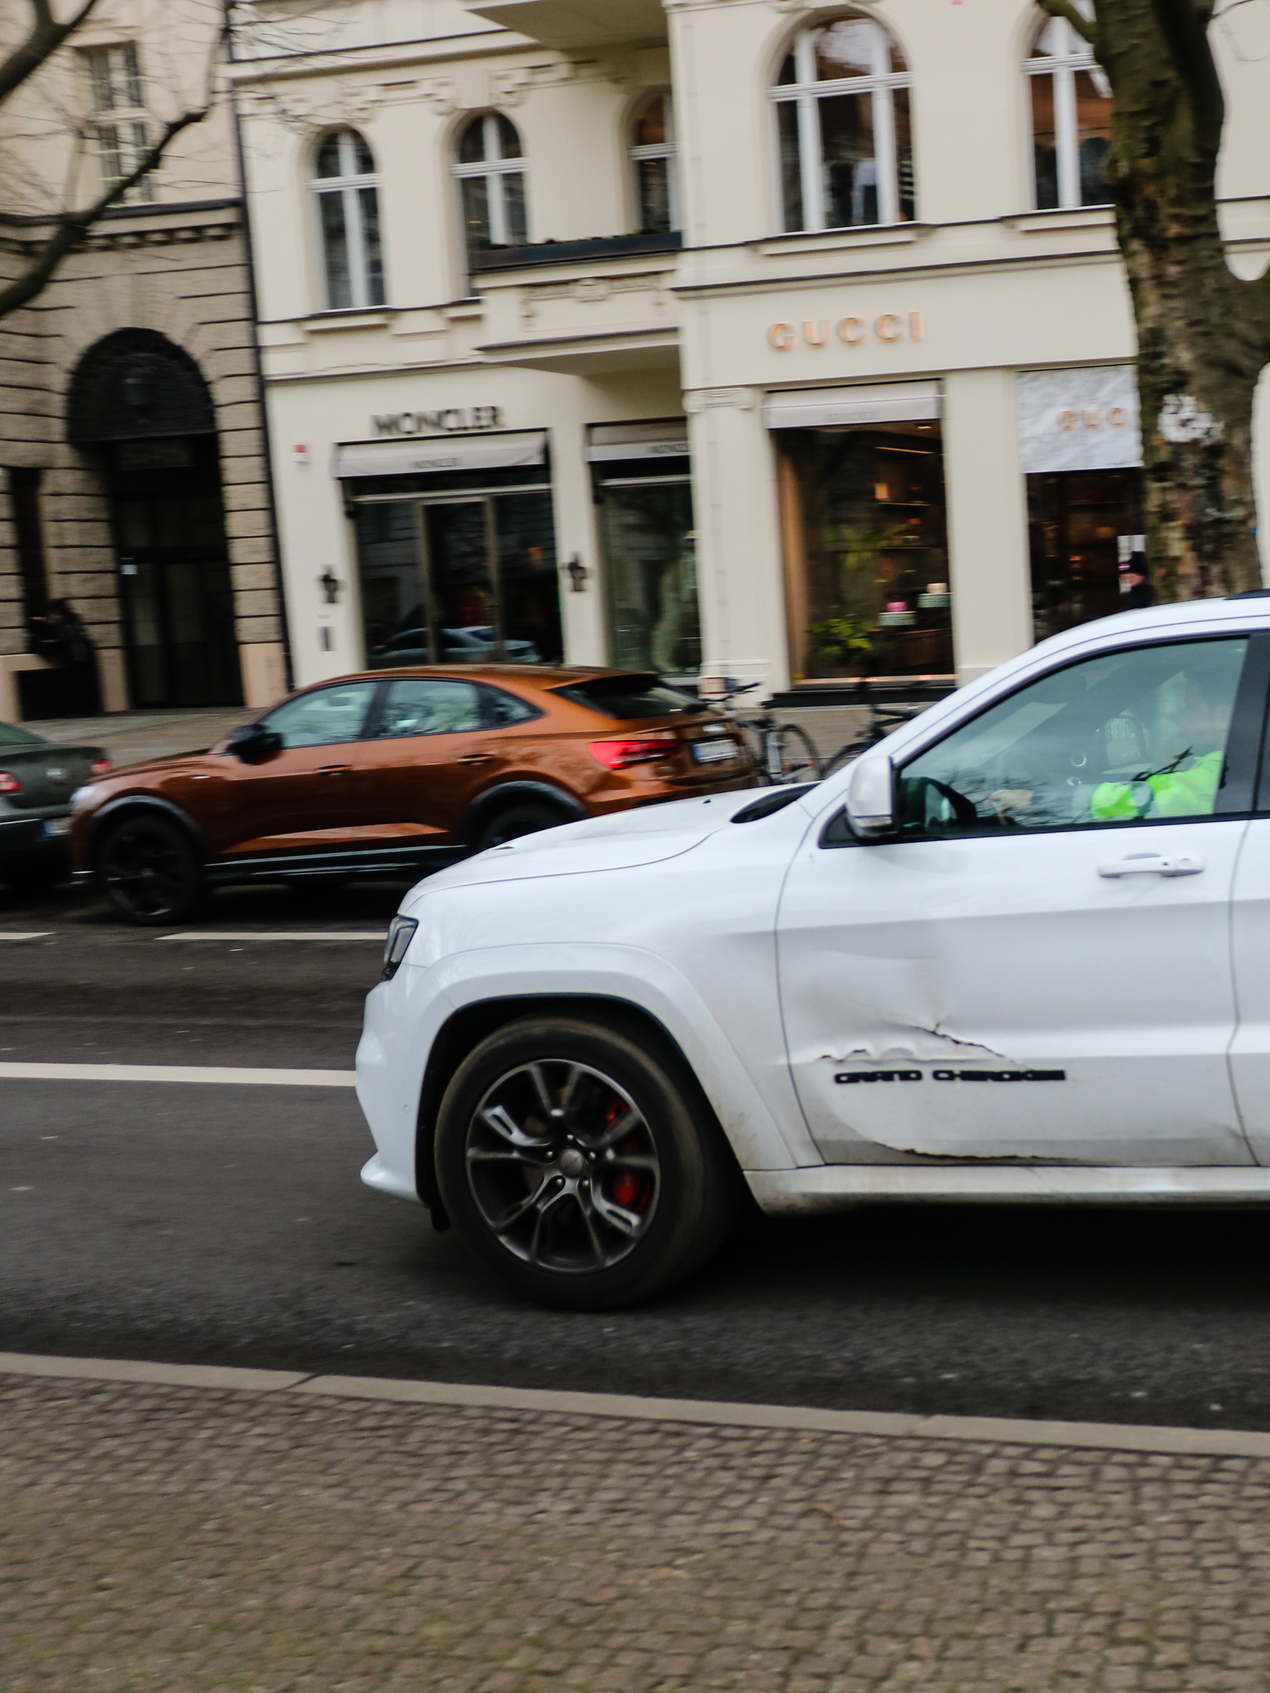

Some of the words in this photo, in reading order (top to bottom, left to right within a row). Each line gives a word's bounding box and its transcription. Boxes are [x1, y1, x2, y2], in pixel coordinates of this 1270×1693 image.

[768, 311, 925, 351] GUCCI
[371, 406, 507, 437] MONCLER
[1057, 407, 1128, 431] GUC
